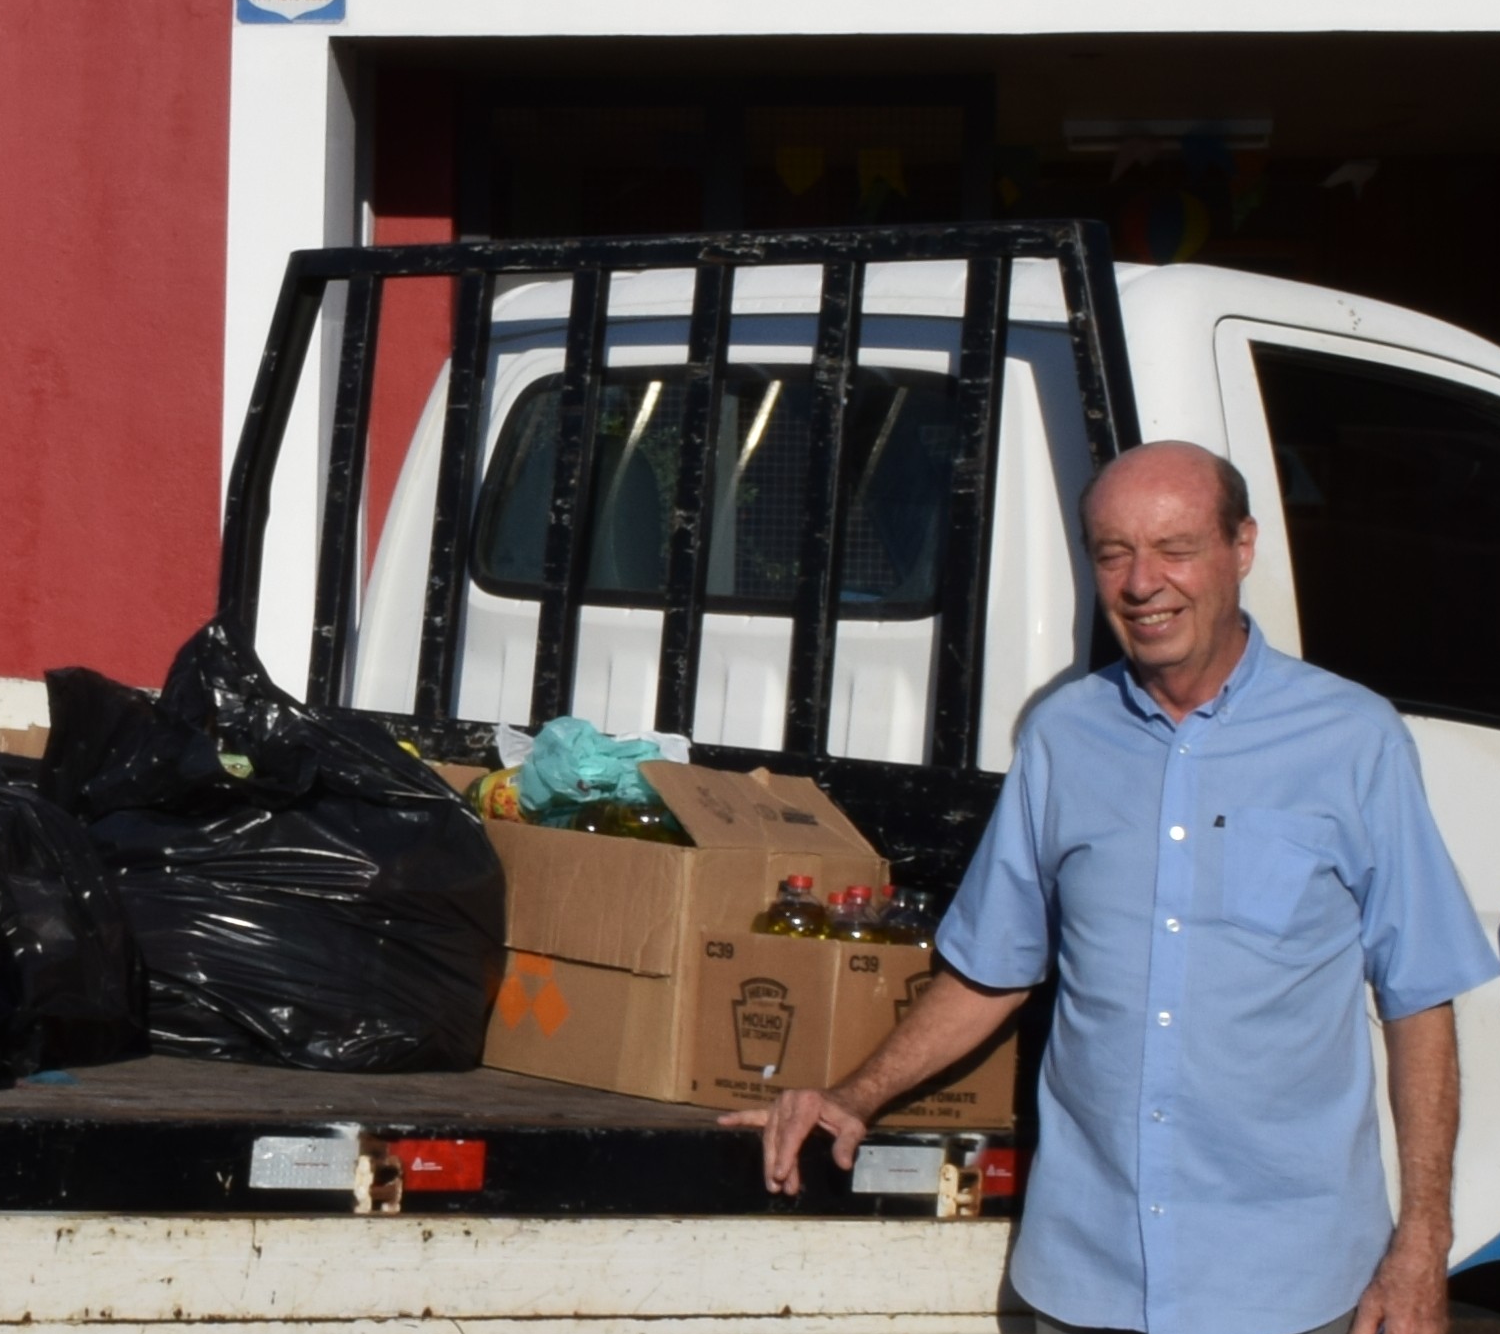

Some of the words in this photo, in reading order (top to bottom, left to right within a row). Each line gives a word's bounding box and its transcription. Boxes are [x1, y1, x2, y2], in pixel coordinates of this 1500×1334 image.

[705, 941, 734, 959] C39
[849, 955, 880, 973] C39
[741, 1011, 783, 1030] MOLHO
